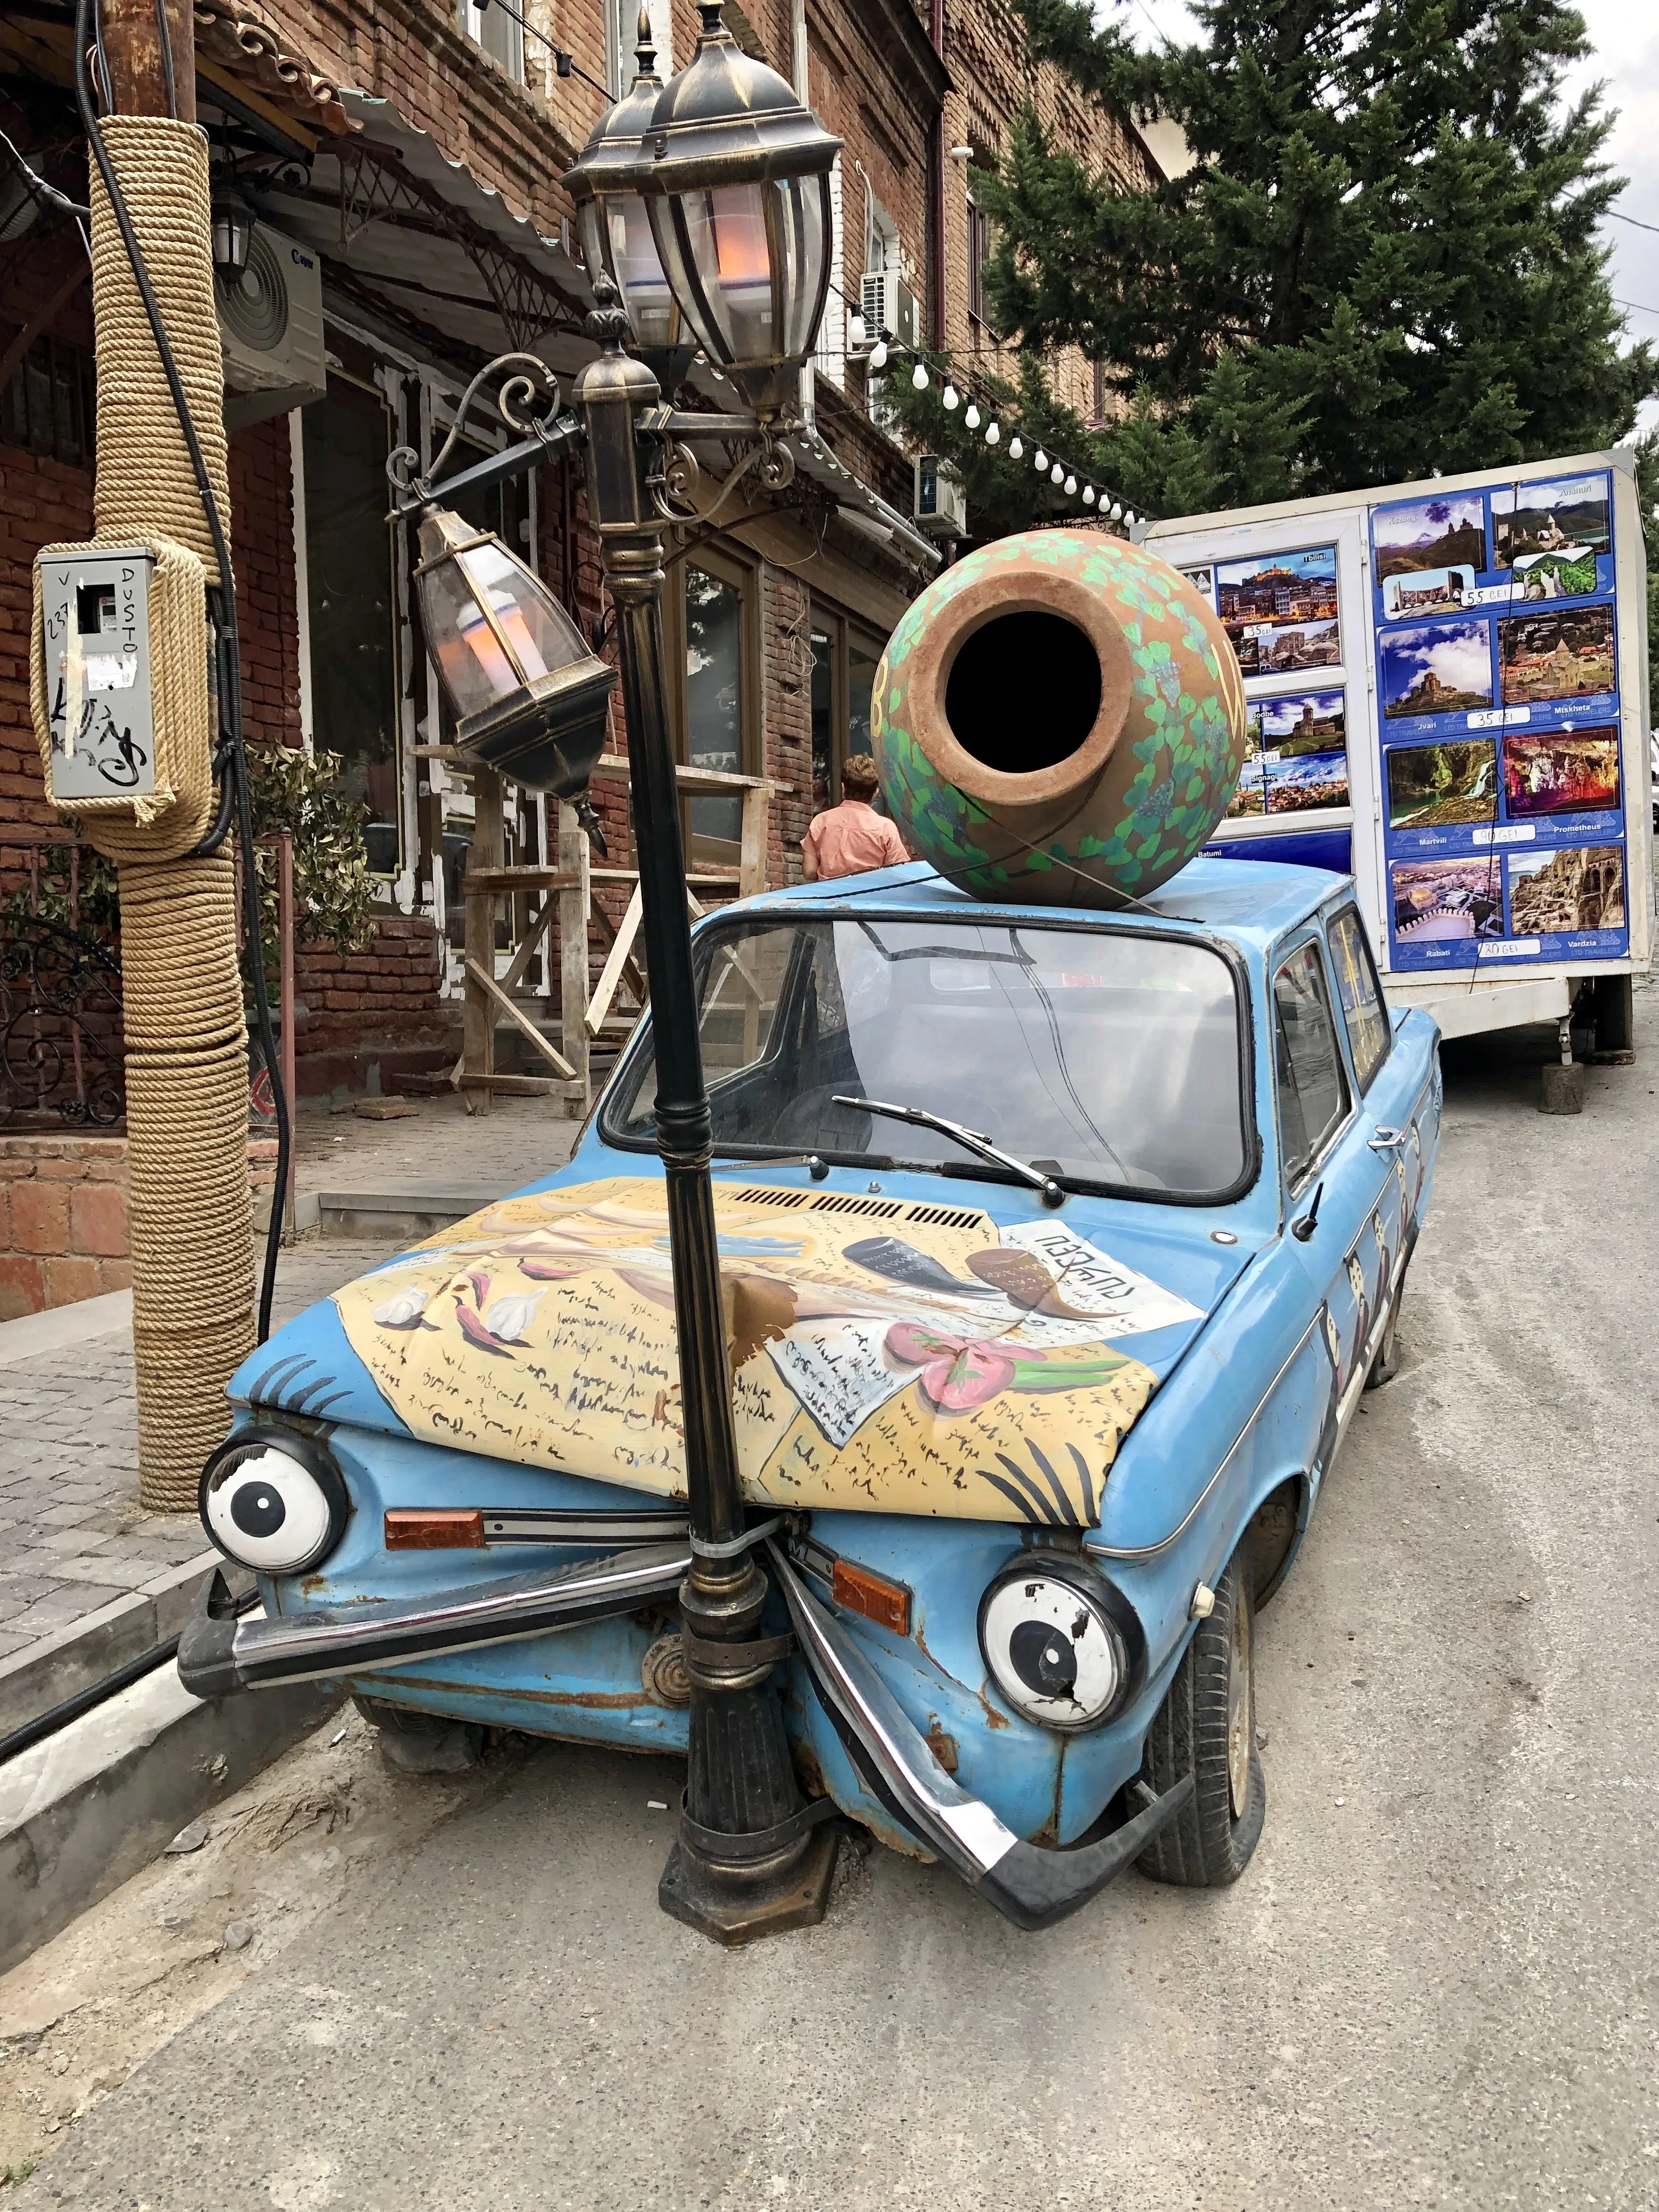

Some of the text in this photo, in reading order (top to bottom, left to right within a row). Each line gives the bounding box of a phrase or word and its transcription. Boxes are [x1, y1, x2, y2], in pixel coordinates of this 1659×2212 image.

[1559, 484, 1591, 497] Ananuri
[1388, 515, 1419, 525] Kazbegi
[1304, 553, 1326, 562] Tbilisi
[1468, 591, 1484, 604] 55
[1248, 625, 1262, 637] 35
[1554, 705, 1591, 714] Mtskheta
[1477, 712, 1494, 727] 35
[1418, 721, 1437, 730] Jvari
[1253, 754, 1266, 765] 55
[1251, 773, 1277, 783] Signagi
[1554, 824, 1602, 833] Prometheus
[1579, 828, 1616, 837] TRAVELERS
[1419, 837, 1447, 845] Martvili
[1198, 849, 1222, 858] Batumi
